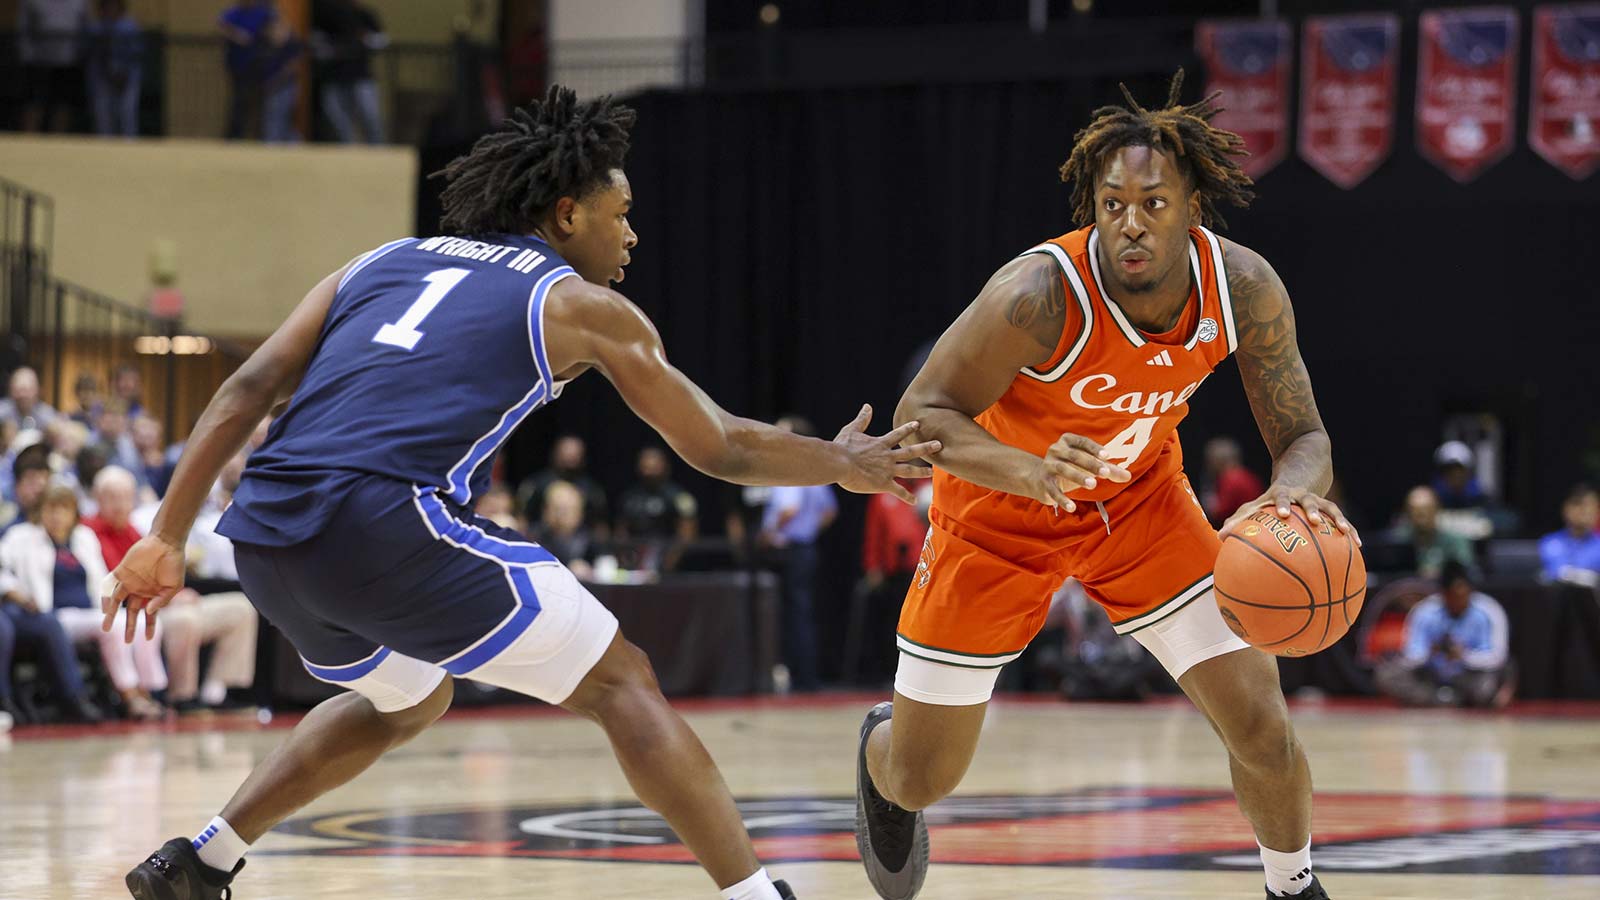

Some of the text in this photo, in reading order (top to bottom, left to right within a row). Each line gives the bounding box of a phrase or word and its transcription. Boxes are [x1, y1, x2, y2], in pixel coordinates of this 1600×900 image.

[416, 236, 547, 274] WRIGHT III
[371, 267, 474, 351] 1
[1069, 373, 1201, 415] Cane
[1104, 416, 1160, 470] 4
[1248, 511, 1308, 554] SPALDI
